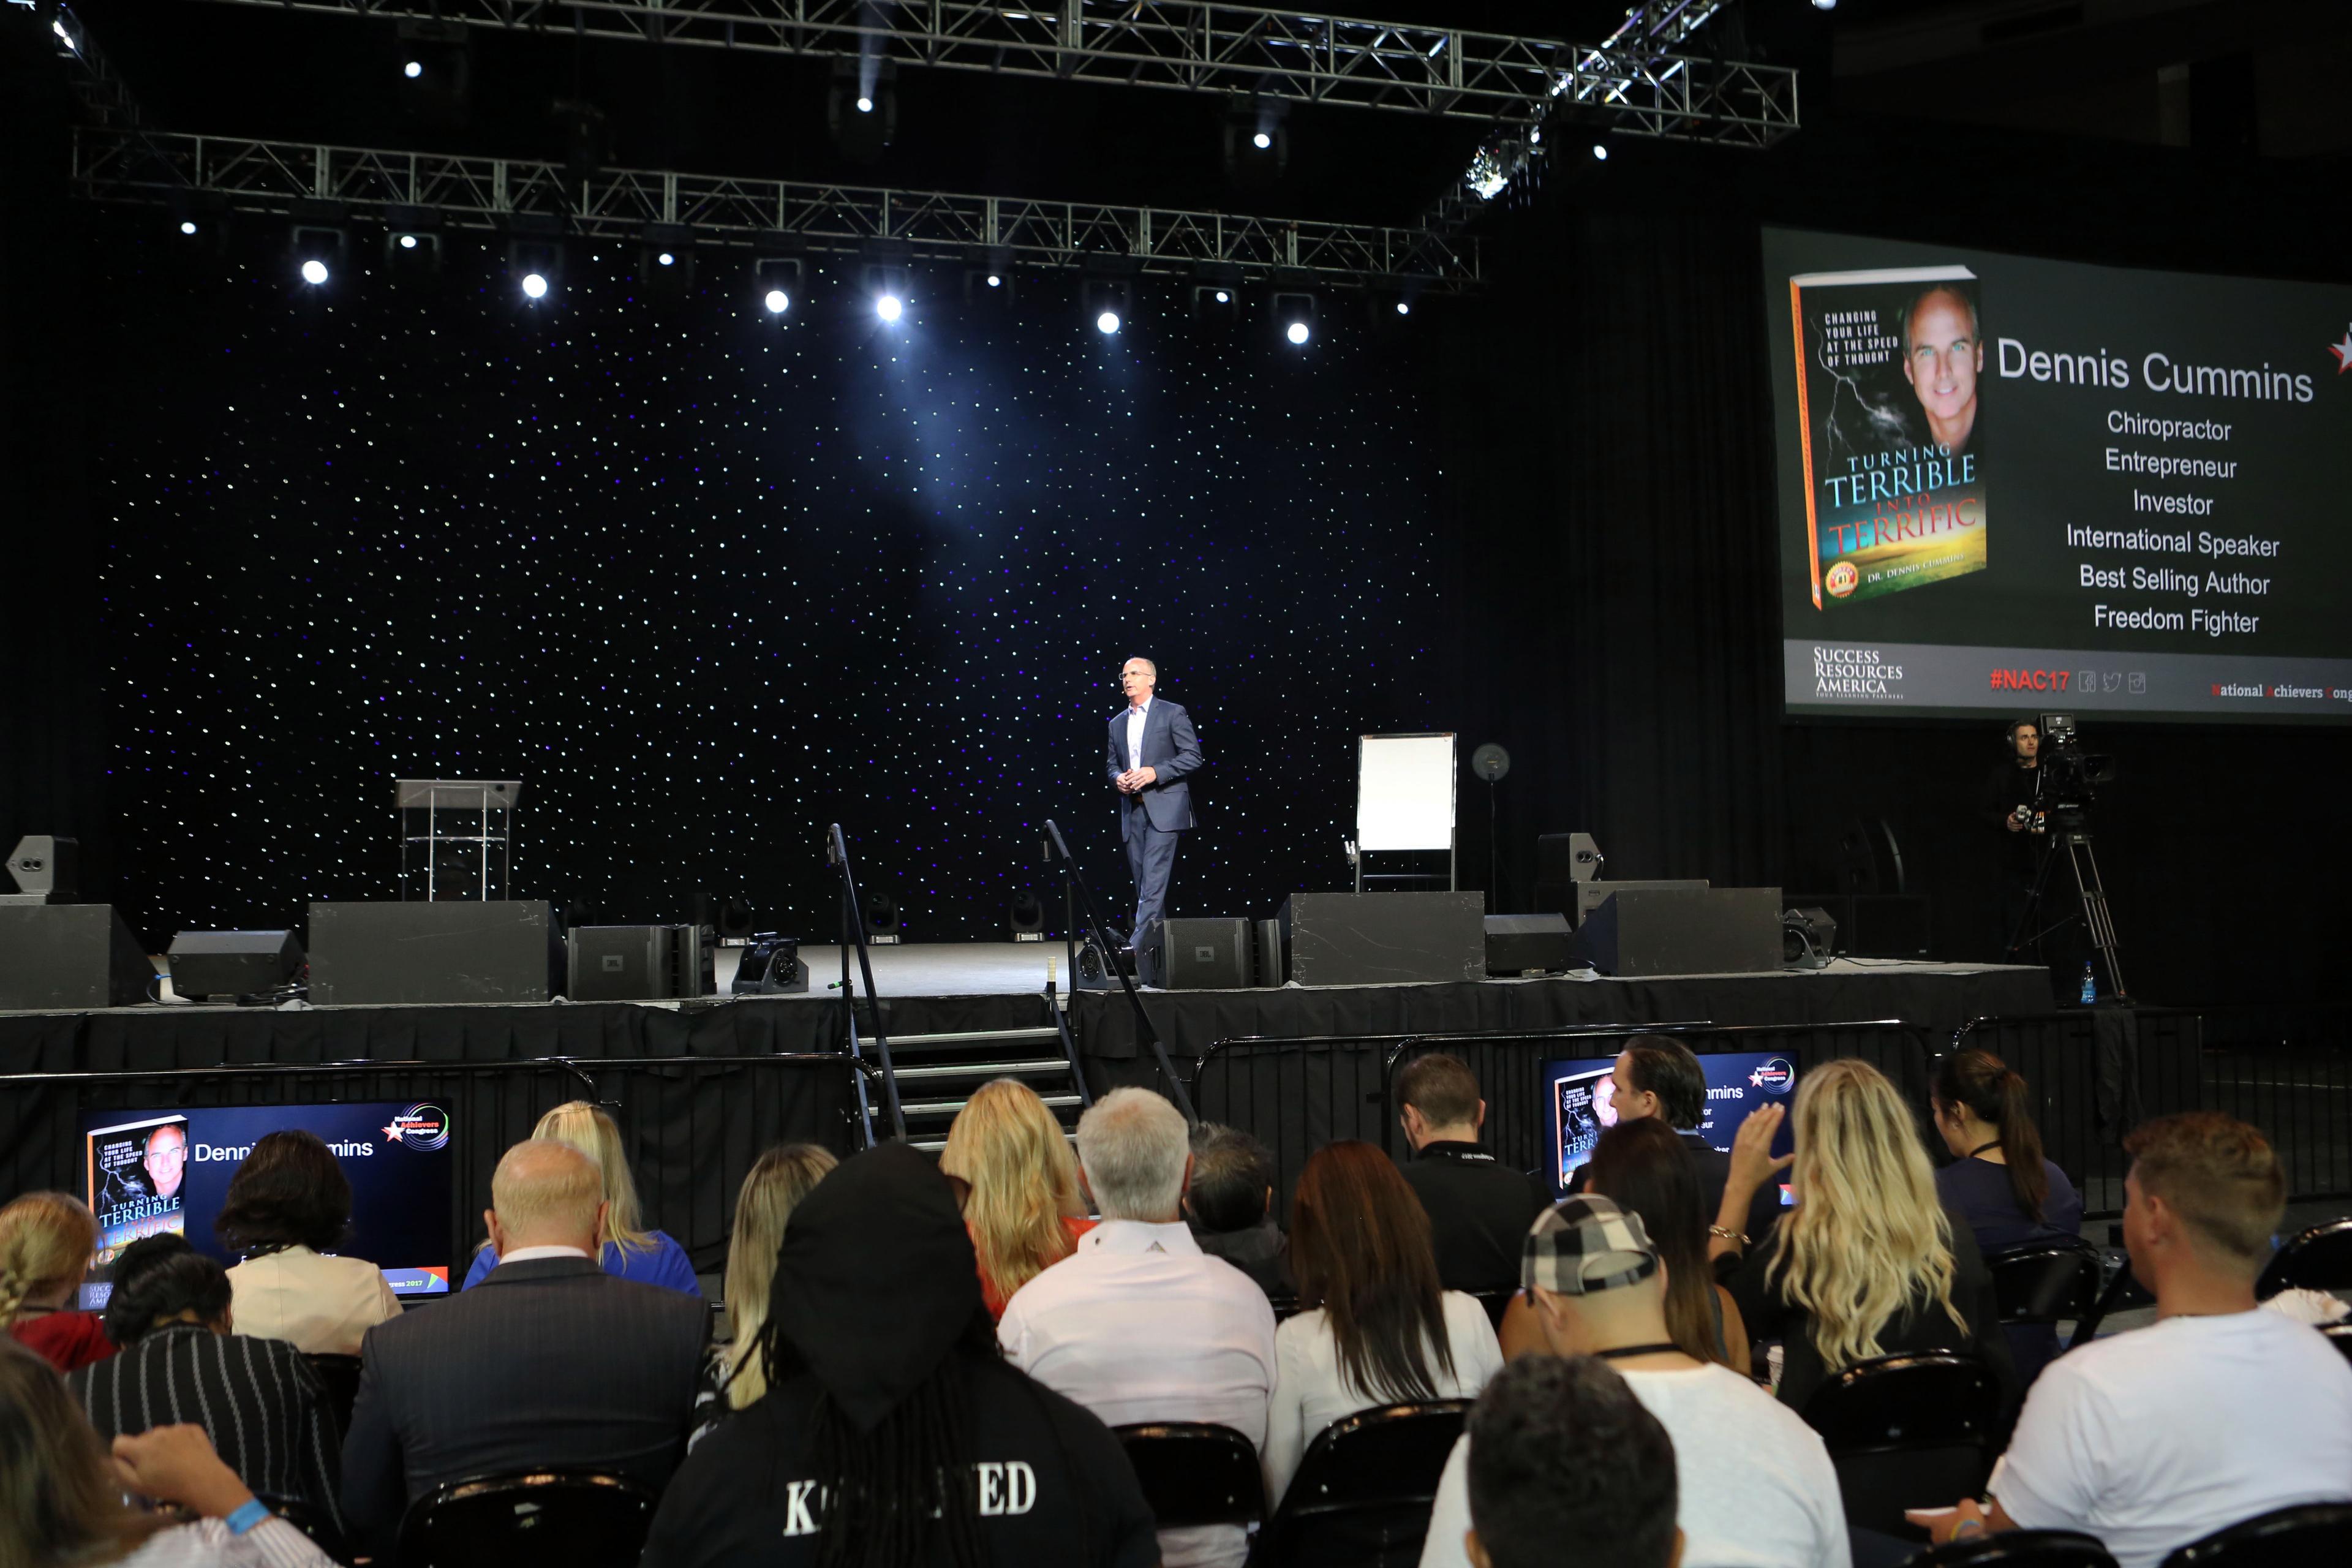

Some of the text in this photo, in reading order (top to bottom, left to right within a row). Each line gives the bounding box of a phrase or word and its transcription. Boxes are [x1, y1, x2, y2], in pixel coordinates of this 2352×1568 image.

[1825, 310, 1876, 325] CHANGING
[1826, 323, 1879, 339] YOUR LIFE
[1827, 336, 1898, 353] AT THE SPEED
[1828, 350, 1890, 368] OF THOUGHT
[1998, 337, 2313, 402] Dennis Cummins
[2107, 410, 2231, 441] Chiropractor
[1847, 442, 1950, 472] TURNING
[2105, 447, 2237, 479] Entrepreneur
[1825, 454, 1975, 508] TERRIBLE
[1877, 493, 1931, 515] INTO
[2133, 489, 2214, 516] Investor
[1828, 498, 1977, 554] TERRIFIC
[2067, 522, 2280, 559] International Speaker
[1868, 572, 1883, 583] DR.
[1887, 563, 1920, 578] DENNIS
[1923, 552, 1964, 569] CUMMINS
[2080, 564, 2271, 597] Best Selling Author
[2094, 605, 2260, 637] Freedom Fighter
[1817, 676, 1887, 693] AMERICA
[1990, 669, 2070, 691] #NAC17
[2211, 683, 2263, 696] National
[2265, 685, 2323, 698] Achievers
[1705, 1085, 1744, 1099] mins
[1564, 1139, 1596, 1156] TERR
[1572, 1133, 1594, 1143] TURN
[99, 1197, 180, 1228] TERRIBLE
[111, 1194, 167, 1212] TURNING
